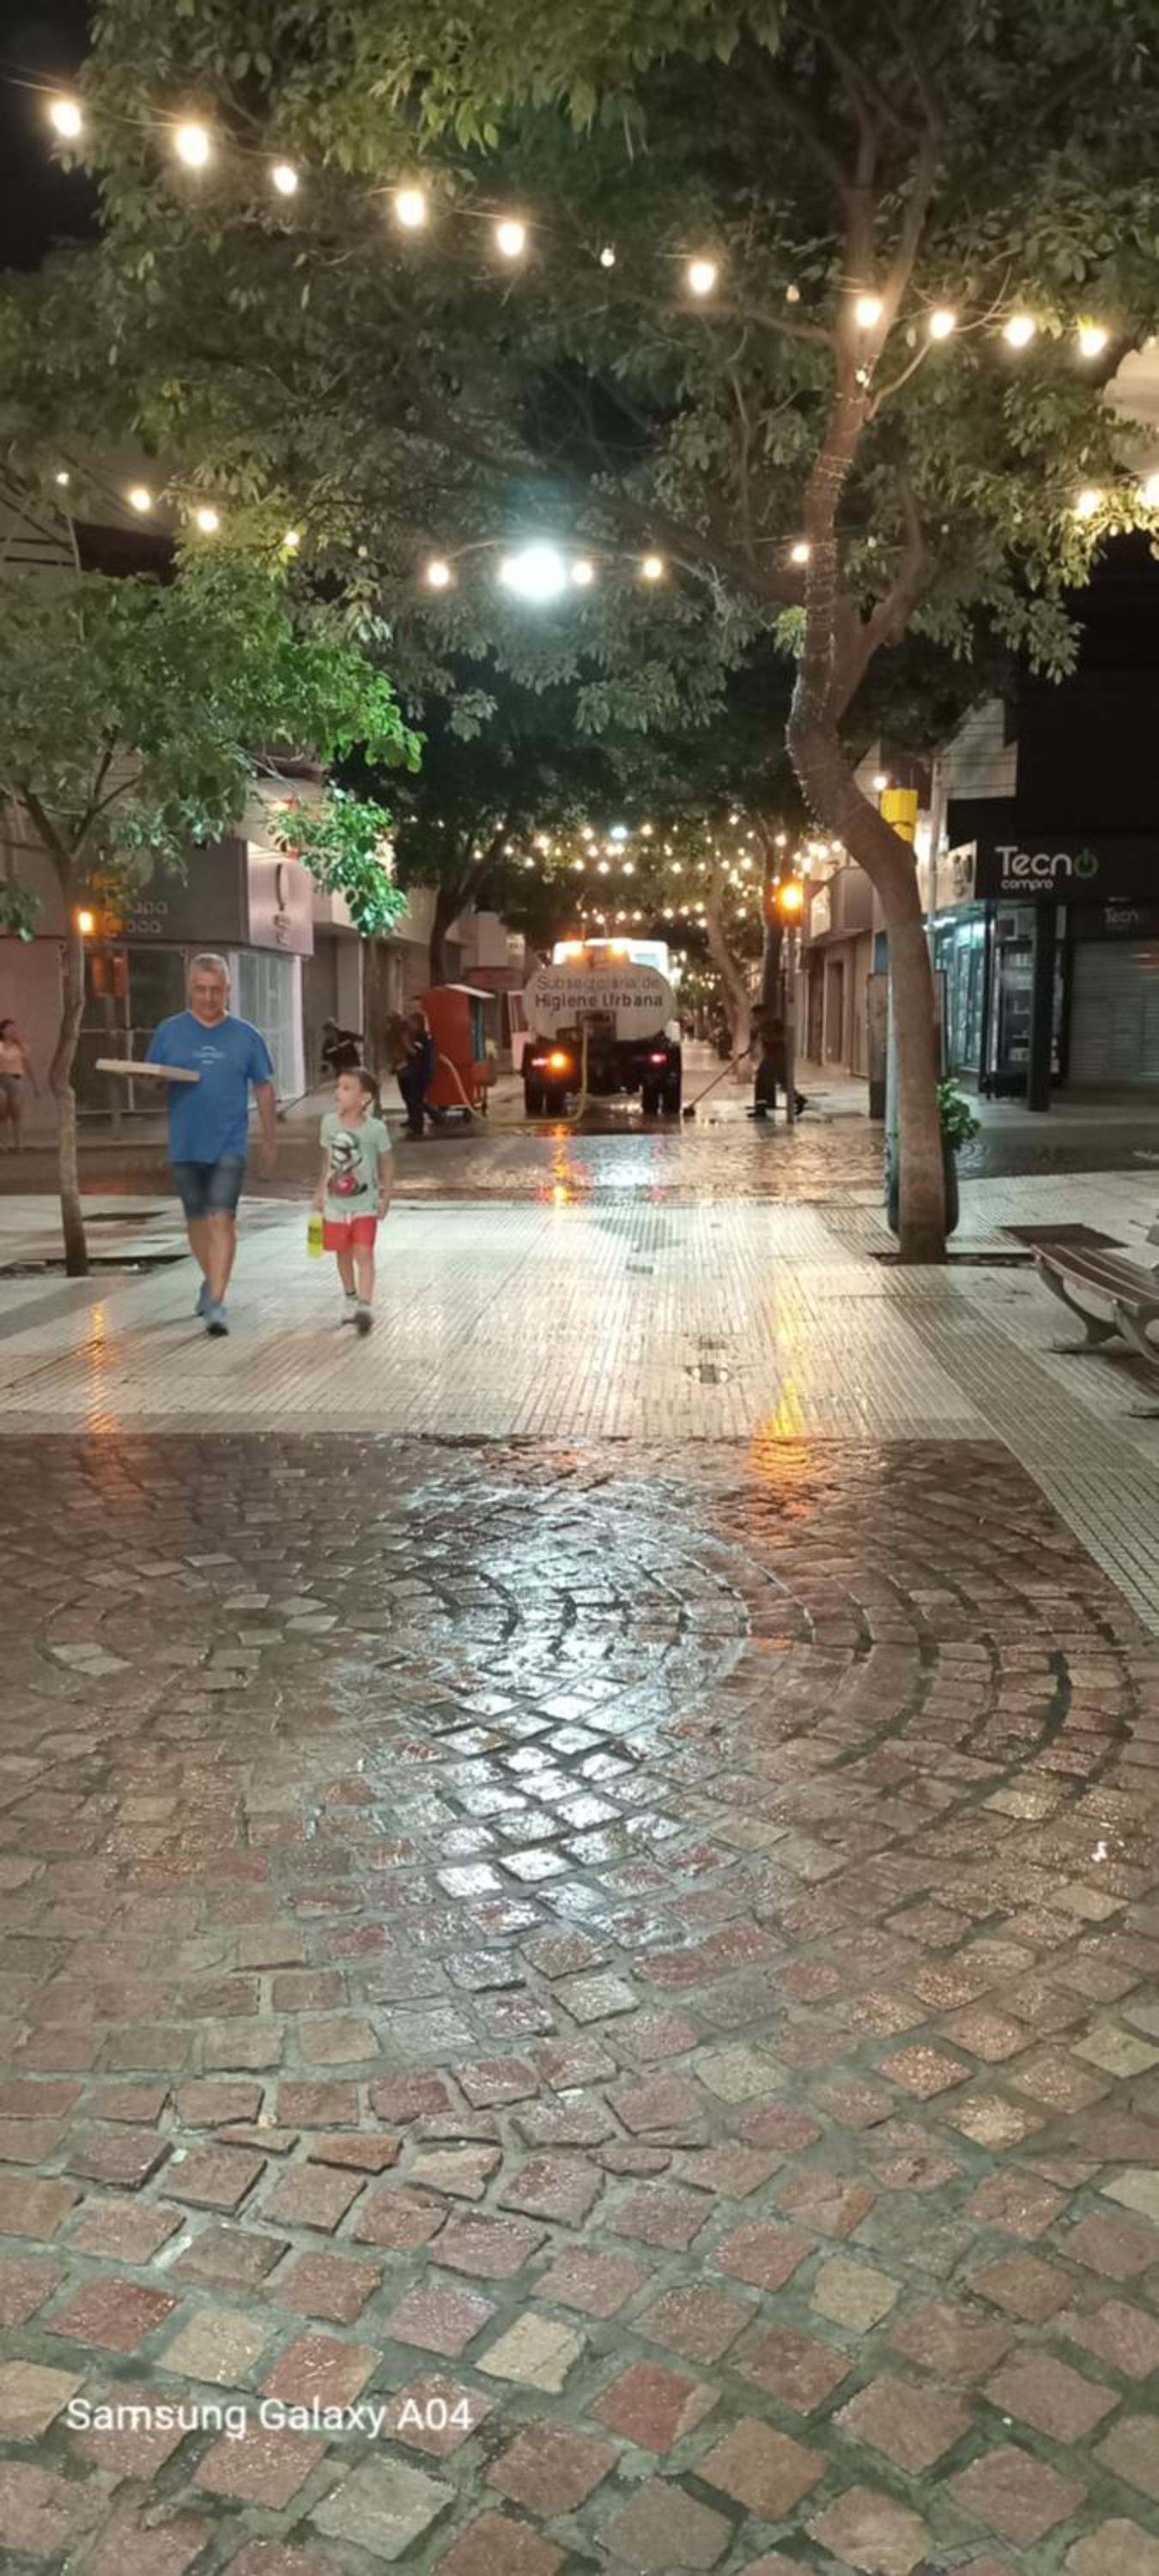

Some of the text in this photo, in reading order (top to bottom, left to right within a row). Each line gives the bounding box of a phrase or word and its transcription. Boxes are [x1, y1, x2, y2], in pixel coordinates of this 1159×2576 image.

[1000, 878, 1054, 891] compro
[642, 975, 660, 990] de
[535, 993, 663, 1012] Higiene Urbana
